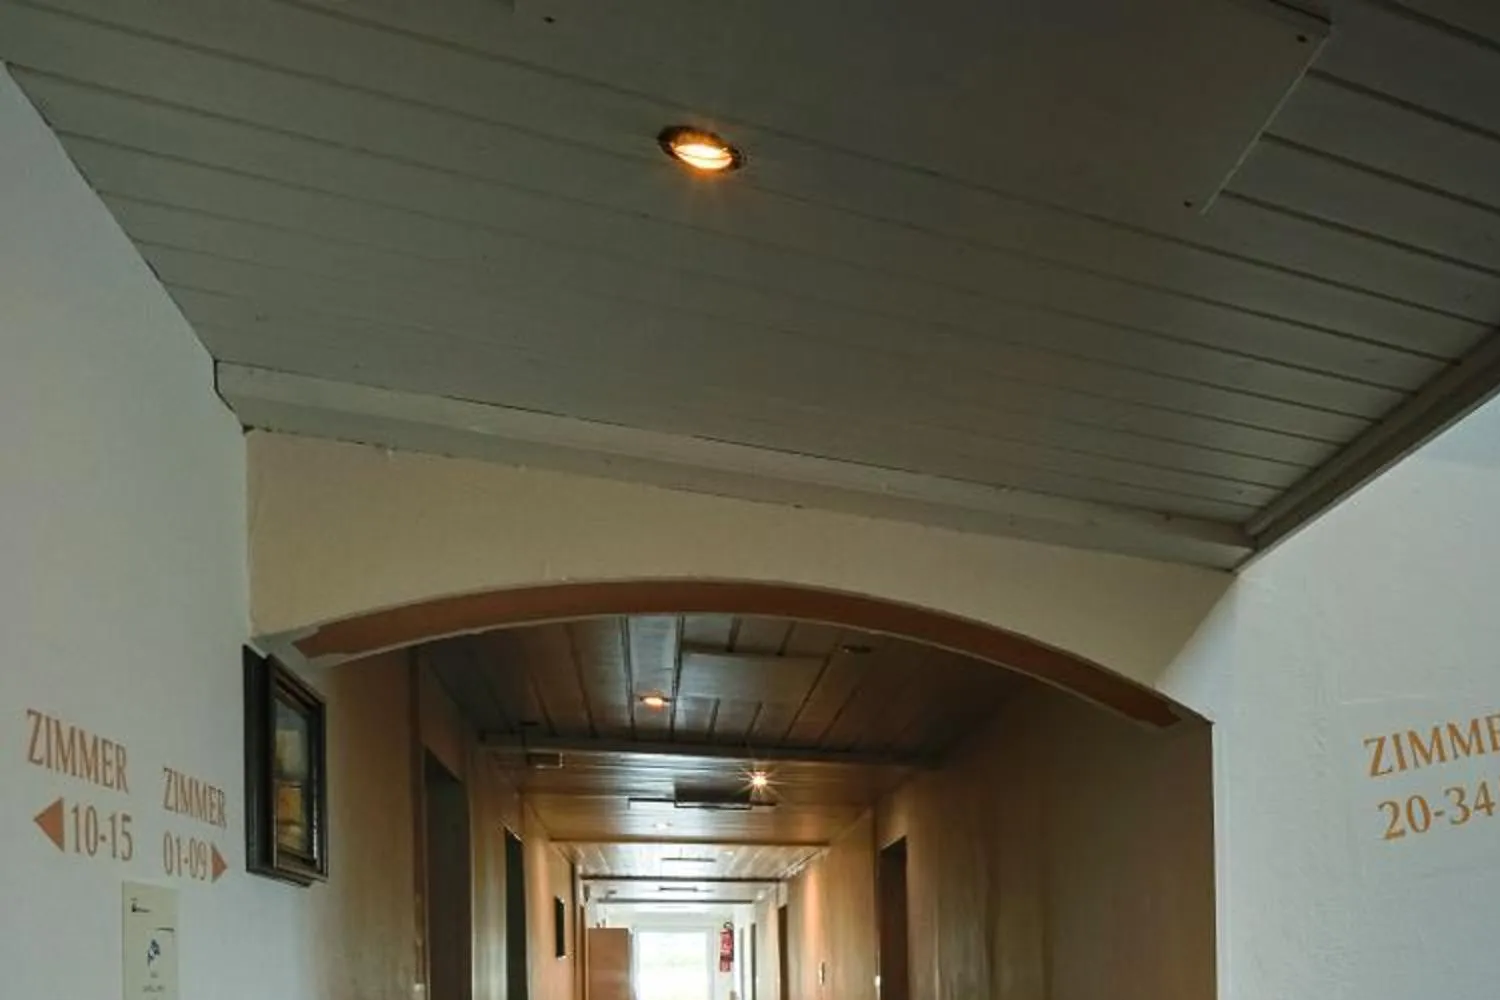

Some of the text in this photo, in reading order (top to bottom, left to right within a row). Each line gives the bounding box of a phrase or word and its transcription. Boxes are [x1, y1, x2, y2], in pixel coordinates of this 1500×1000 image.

[26, 709, 129, 794] ZIMMER
[163, 767, 228, 829] ZIMMER
[1377, 780, 1496, 840] 20-34
[71, 804, 133, 862] 10-15
[162, 832, 208, 880] 01-09
